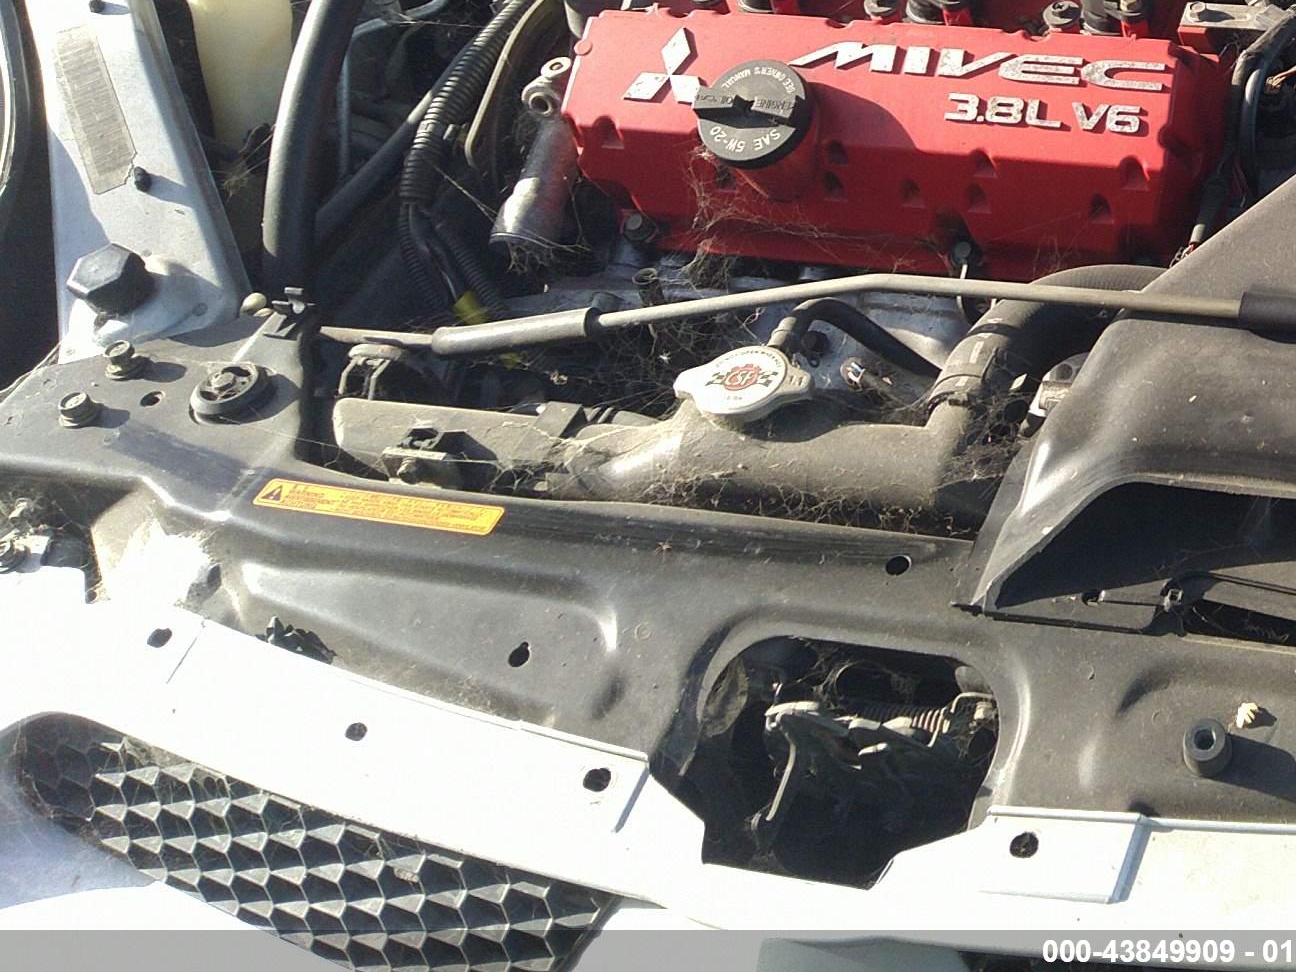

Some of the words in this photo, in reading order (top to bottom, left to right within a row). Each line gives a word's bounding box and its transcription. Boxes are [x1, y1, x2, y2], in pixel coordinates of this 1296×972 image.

[788, 41, 1165, 92] MIVEC
[722, 69, 752, 89] MANUAL
[944, 93, 1061, 129] 3.8L
[1071, 101, 1142, 134] V6
[710, 126, 746, 153] 5W-20
[753, 129, 781, 150] SAE
[725, 370, 755, 386] CSF
